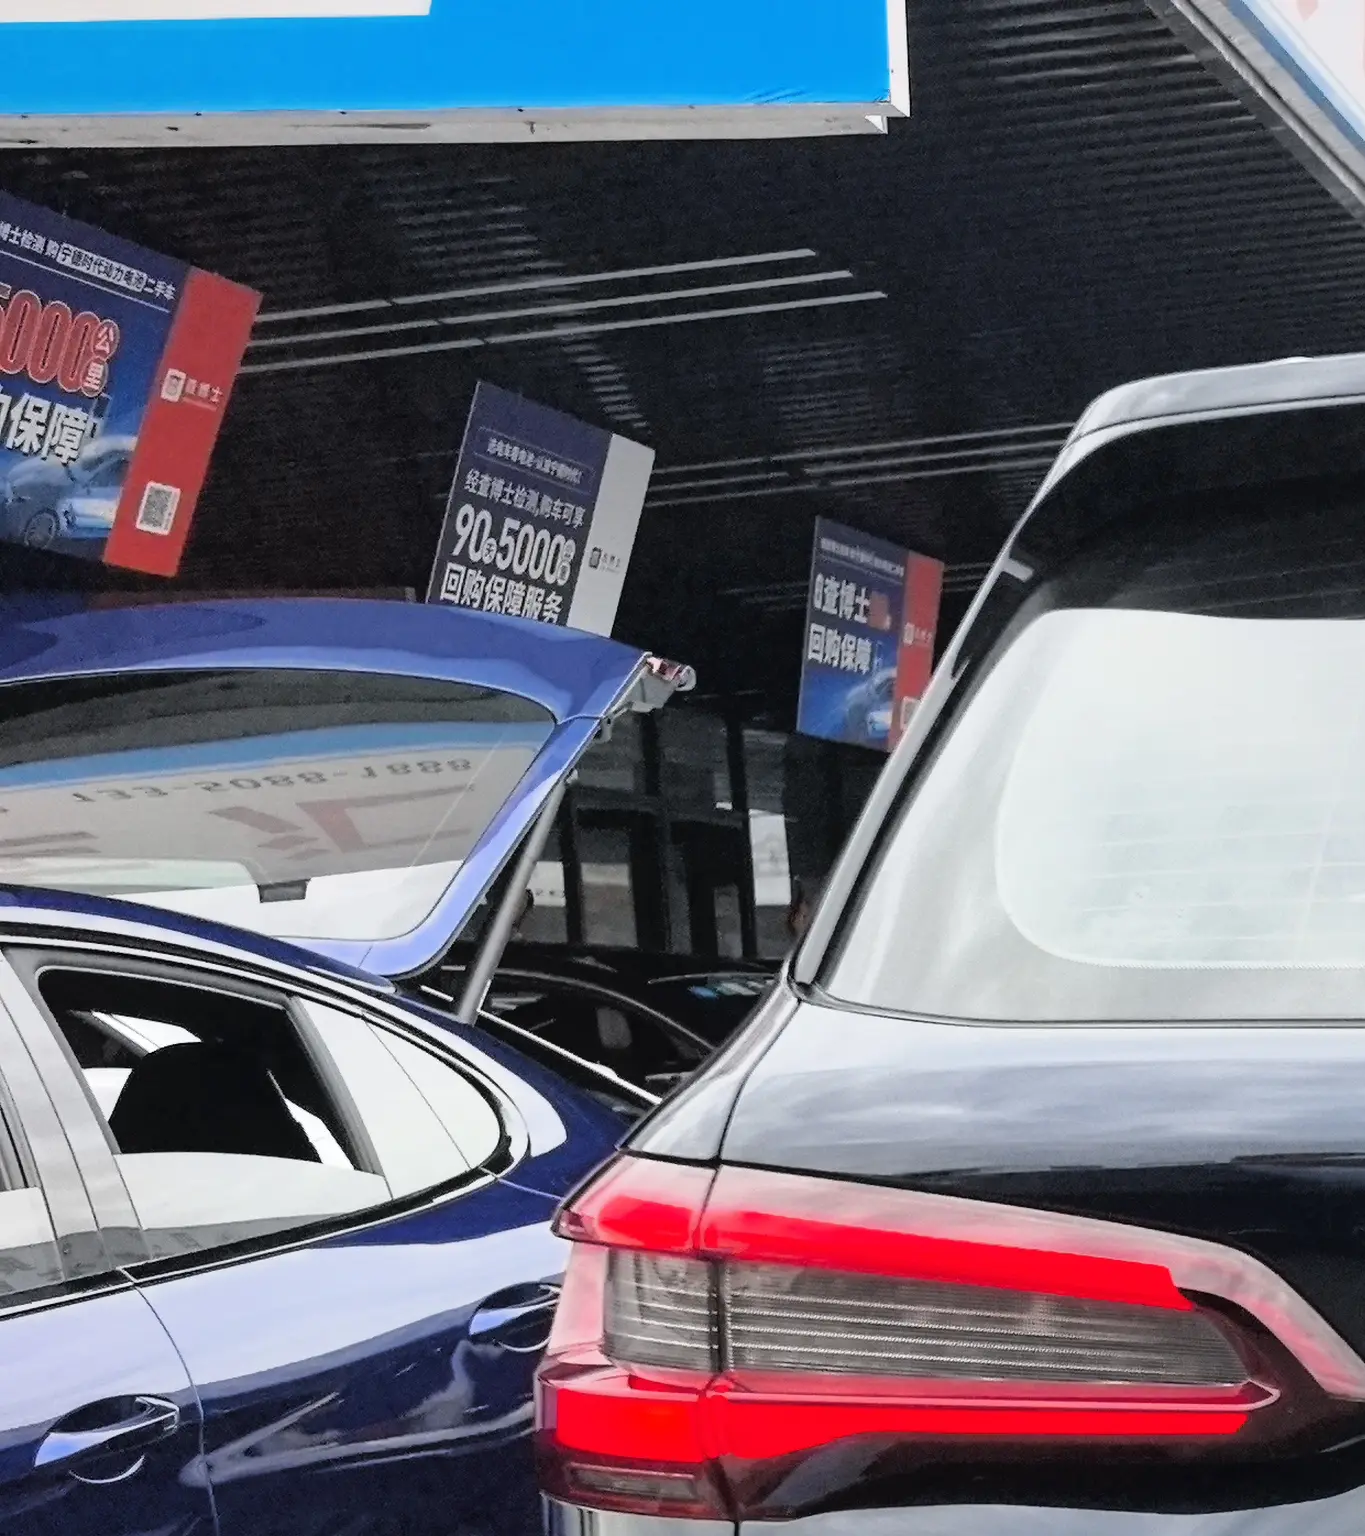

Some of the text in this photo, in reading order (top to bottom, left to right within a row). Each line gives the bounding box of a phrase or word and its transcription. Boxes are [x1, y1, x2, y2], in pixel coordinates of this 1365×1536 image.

[440, 562, 563, 624] 回购保障服务
